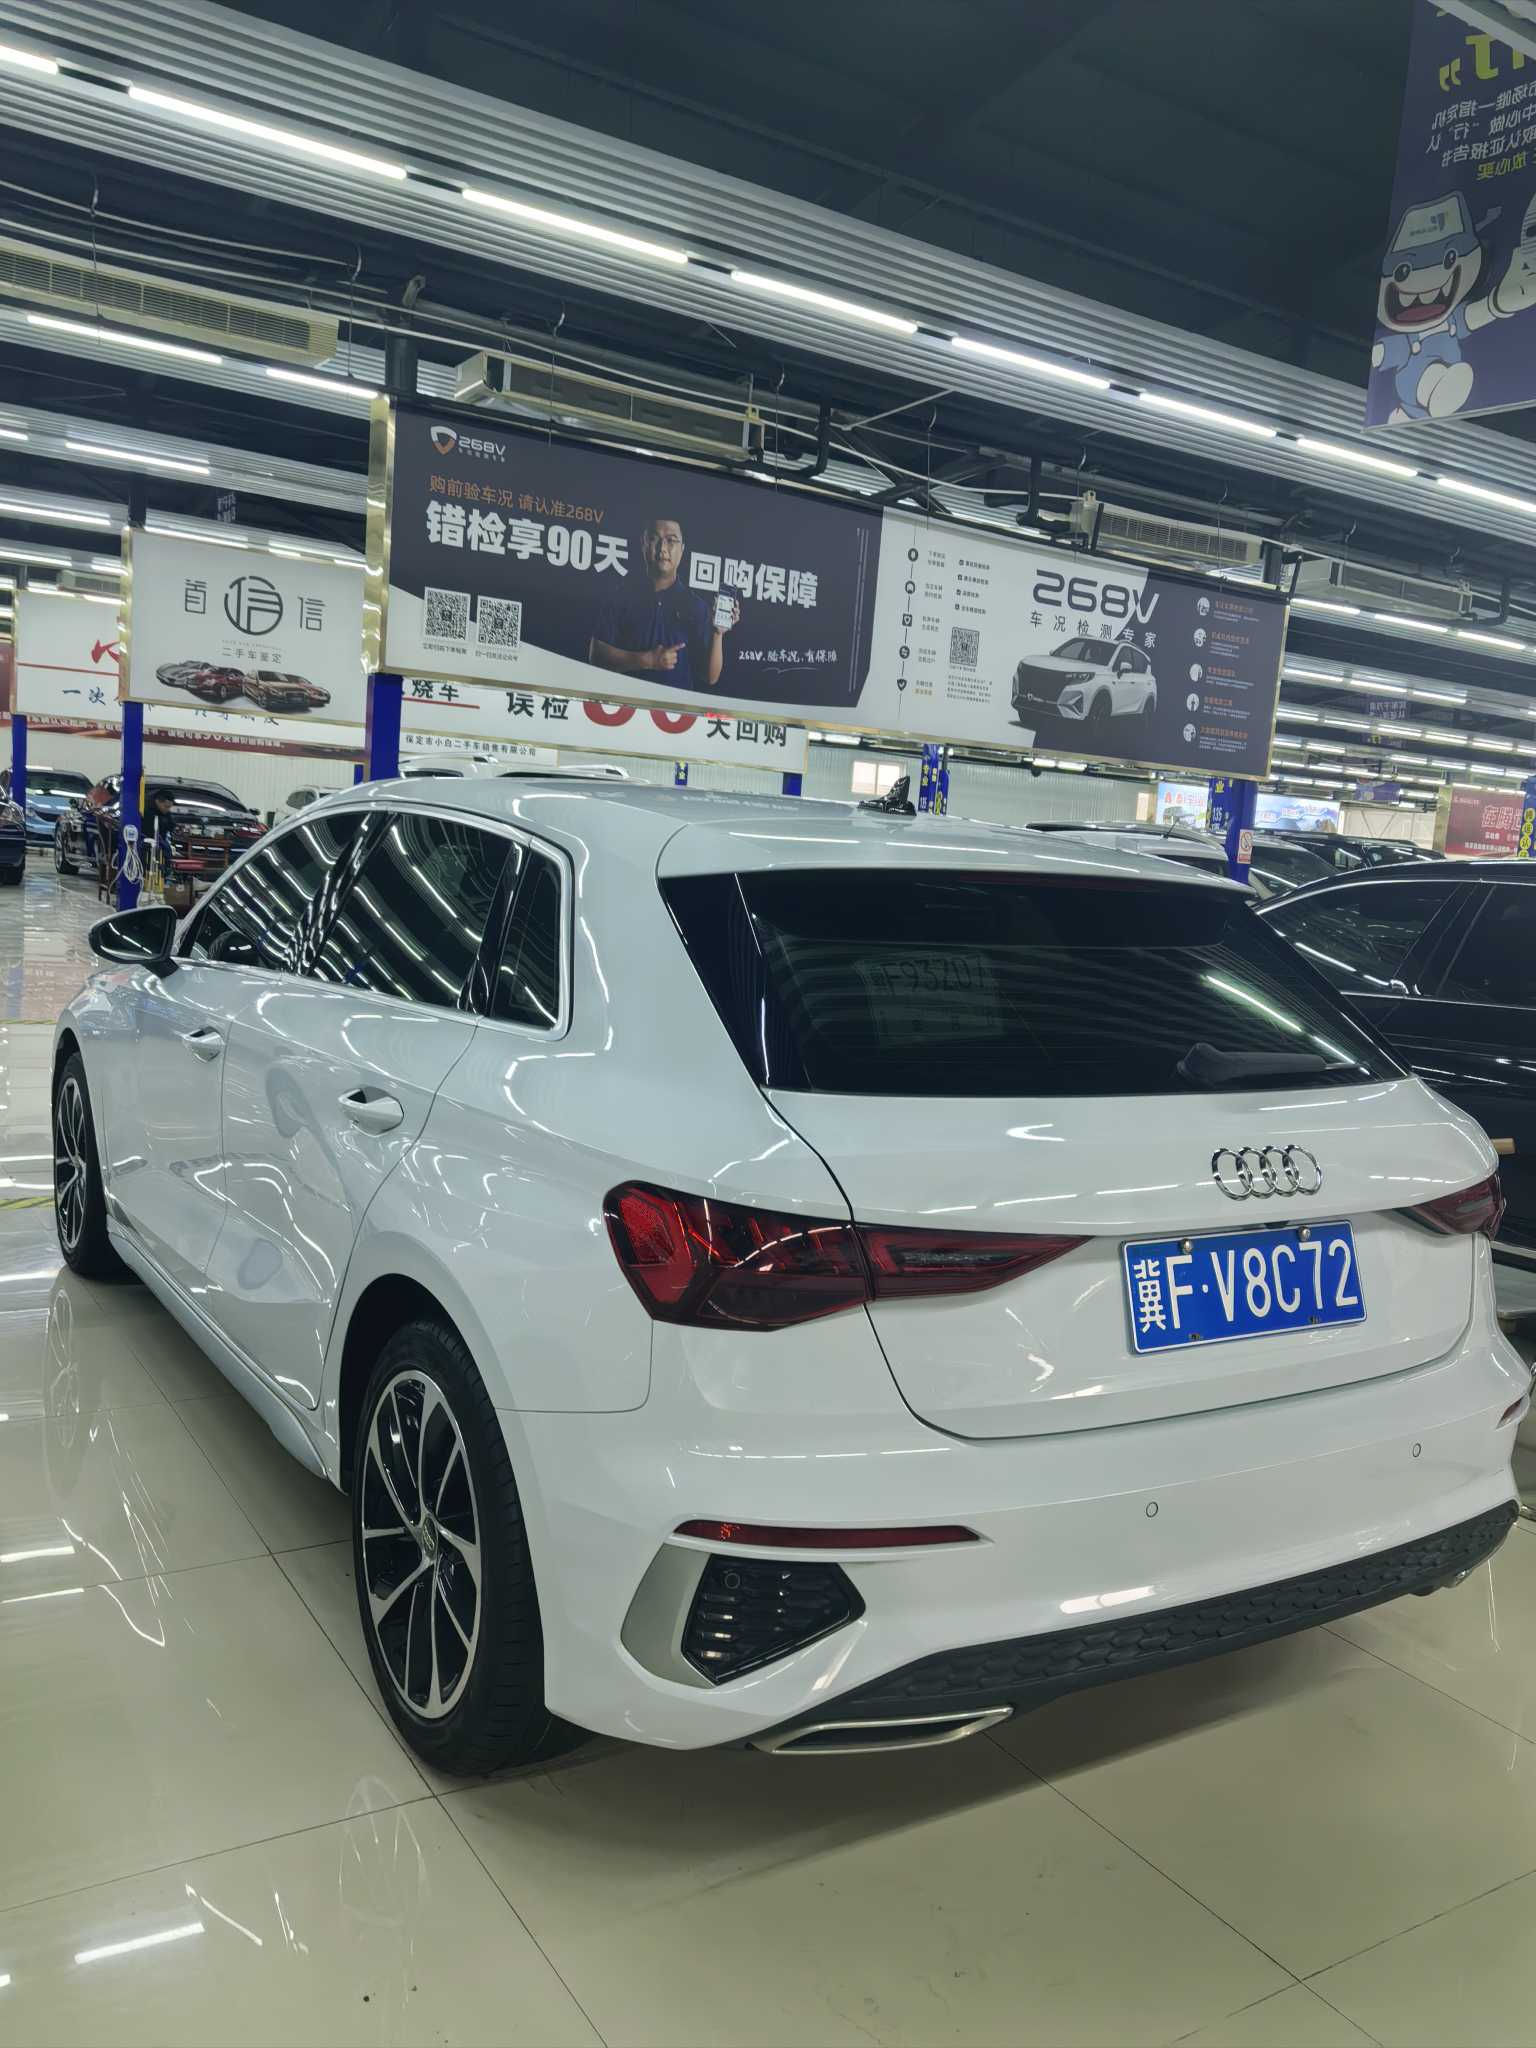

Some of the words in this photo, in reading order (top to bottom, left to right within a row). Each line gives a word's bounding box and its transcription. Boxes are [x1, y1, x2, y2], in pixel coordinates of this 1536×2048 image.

[458, 435, 506, 455] 268V
[429, 474, 514, 510] 购前验车况
[519, 493, 605, 525] 请认准268V
[425, 500, 630, 577] 错检享90天
[688, 551, 820, 609] 回购保障
[1032, 568, 1160, 625] 268V
[1029, 609, 1159, 649] 车况检测专家
[1133, 1238, 1359, 1334] 冀F·V8C72
